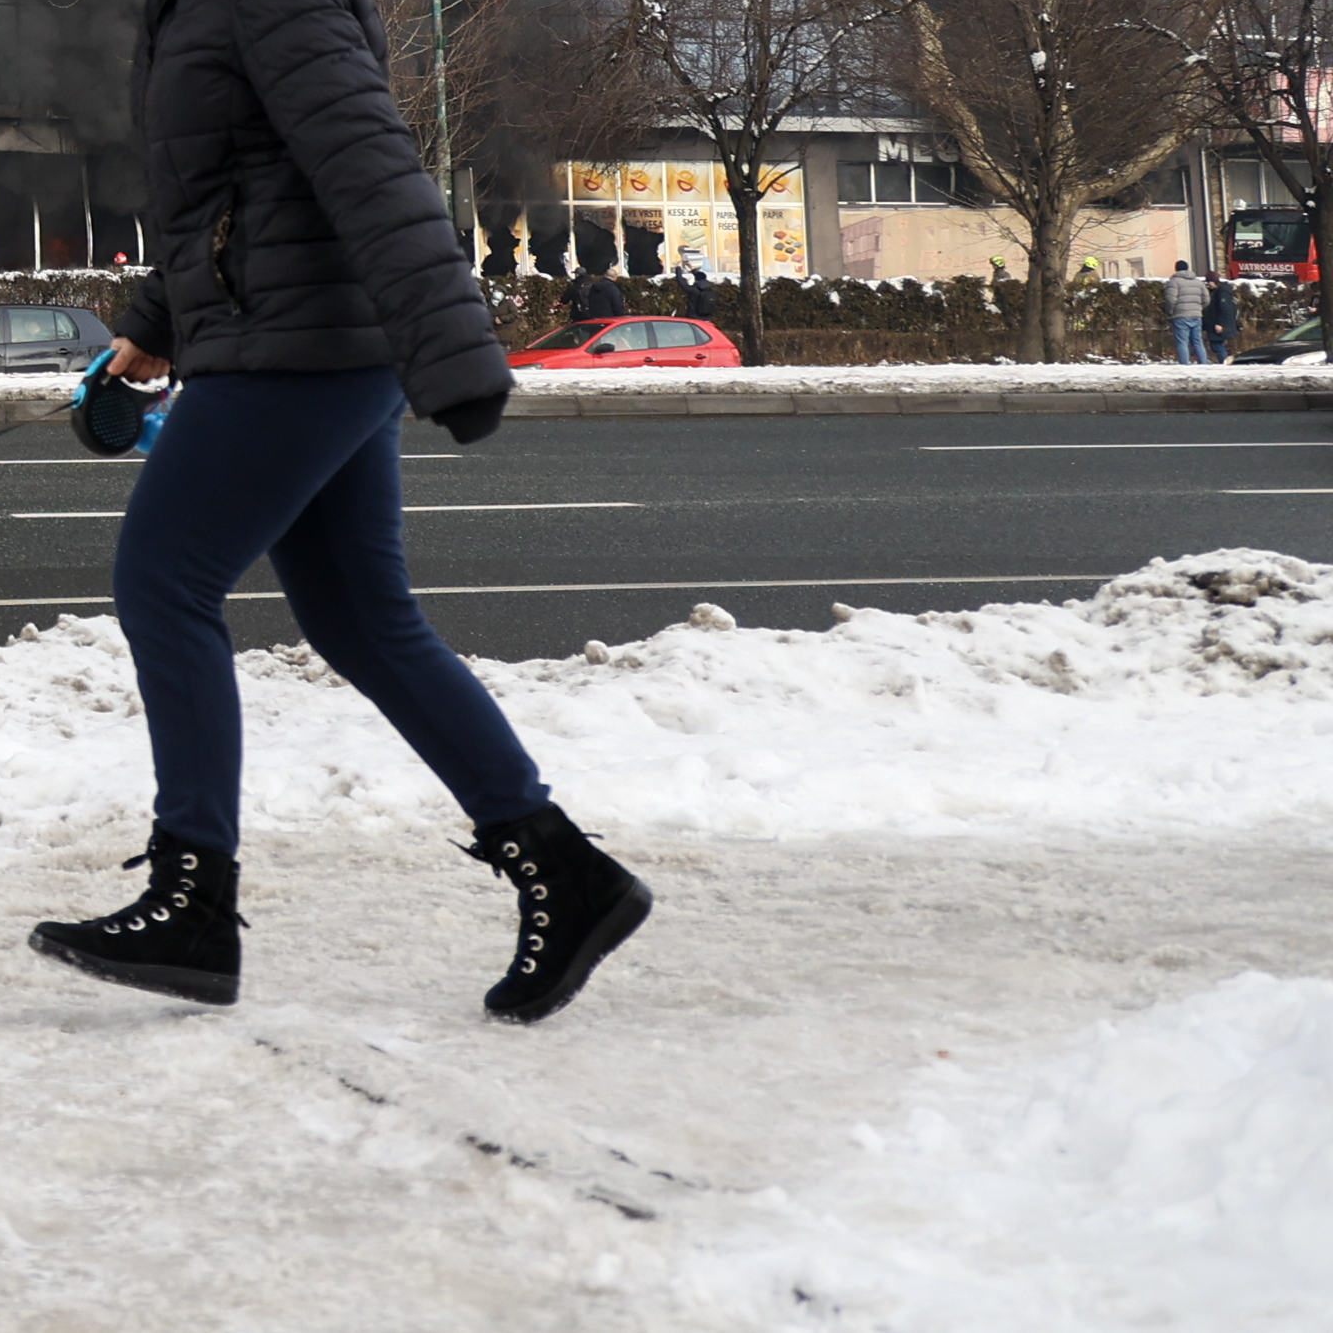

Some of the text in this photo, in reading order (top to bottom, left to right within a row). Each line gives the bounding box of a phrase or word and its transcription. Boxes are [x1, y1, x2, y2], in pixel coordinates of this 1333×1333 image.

[639, 210, 663, 218] VRSTE
[668, 208, 699, 216] KESE ZA
[762, 211, 783, 219] PAPIR
[1238, 263, 1295, 272] VATROGASCI
